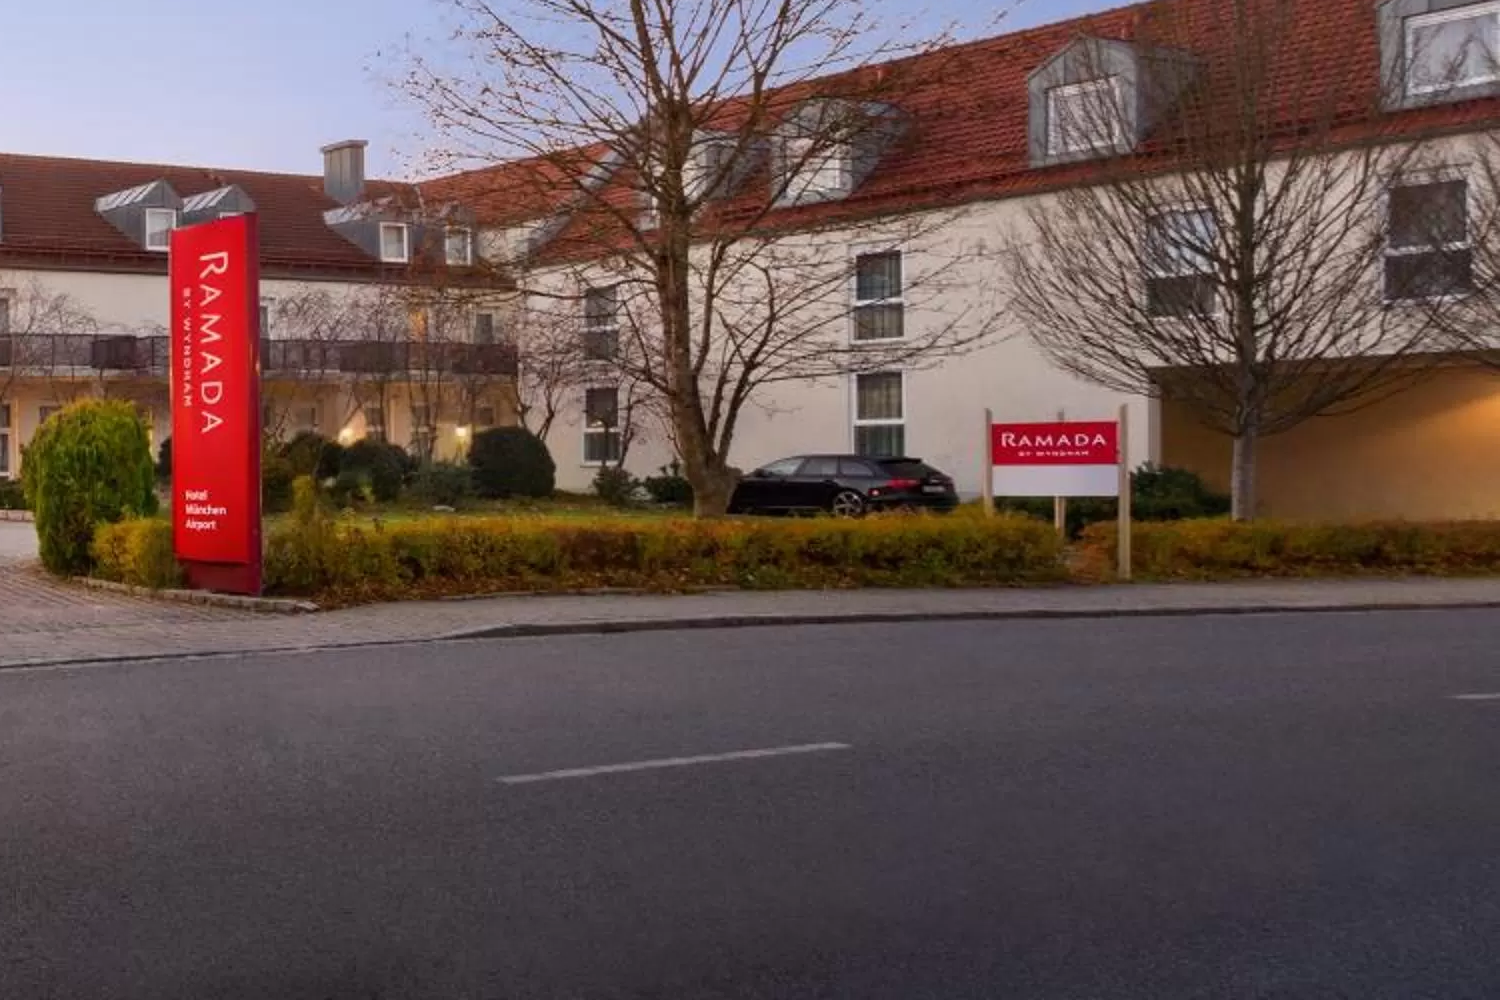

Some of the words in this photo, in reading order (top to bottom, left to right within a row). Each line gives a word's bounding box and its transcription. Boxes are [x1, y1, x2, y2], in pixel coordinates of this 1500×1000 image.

[183, 287, 191, 309] BY
[183, 316, 192, 407] WYNDHAM
[199, 251, 228, 433] RAMADA
[1001, 432, 1106, 447] RAMADA
